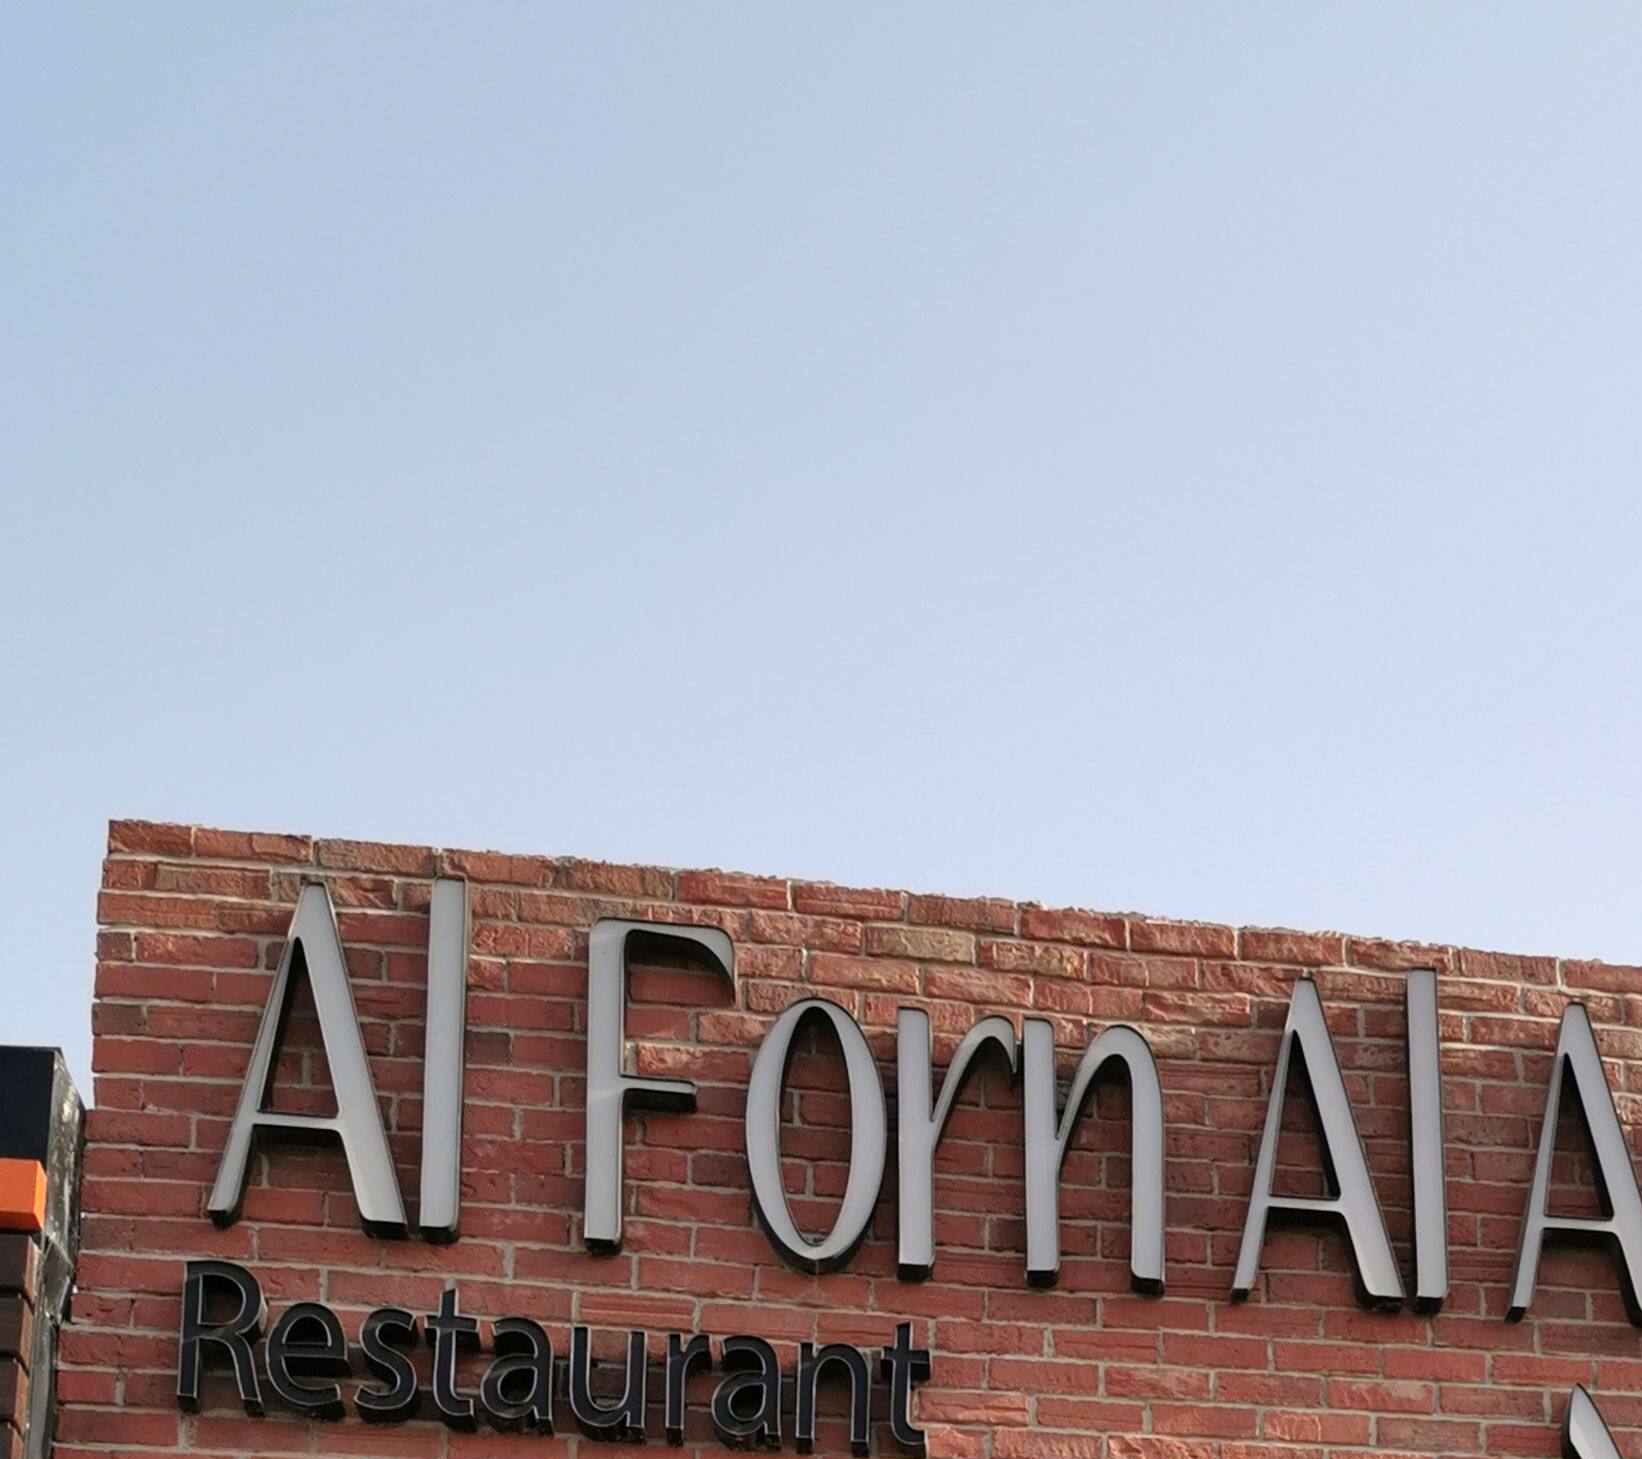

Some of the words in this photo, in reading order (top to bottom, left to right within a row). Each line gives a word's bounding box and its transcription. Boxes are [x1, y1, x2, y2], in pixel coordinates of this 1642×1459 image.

[207, 877, 470, 1242] Al
[584, 917, 1167, 1298] Forn
[1231, 968, 1450, 1314] Al
[178, 1260, 931, 1459] Restaurant
